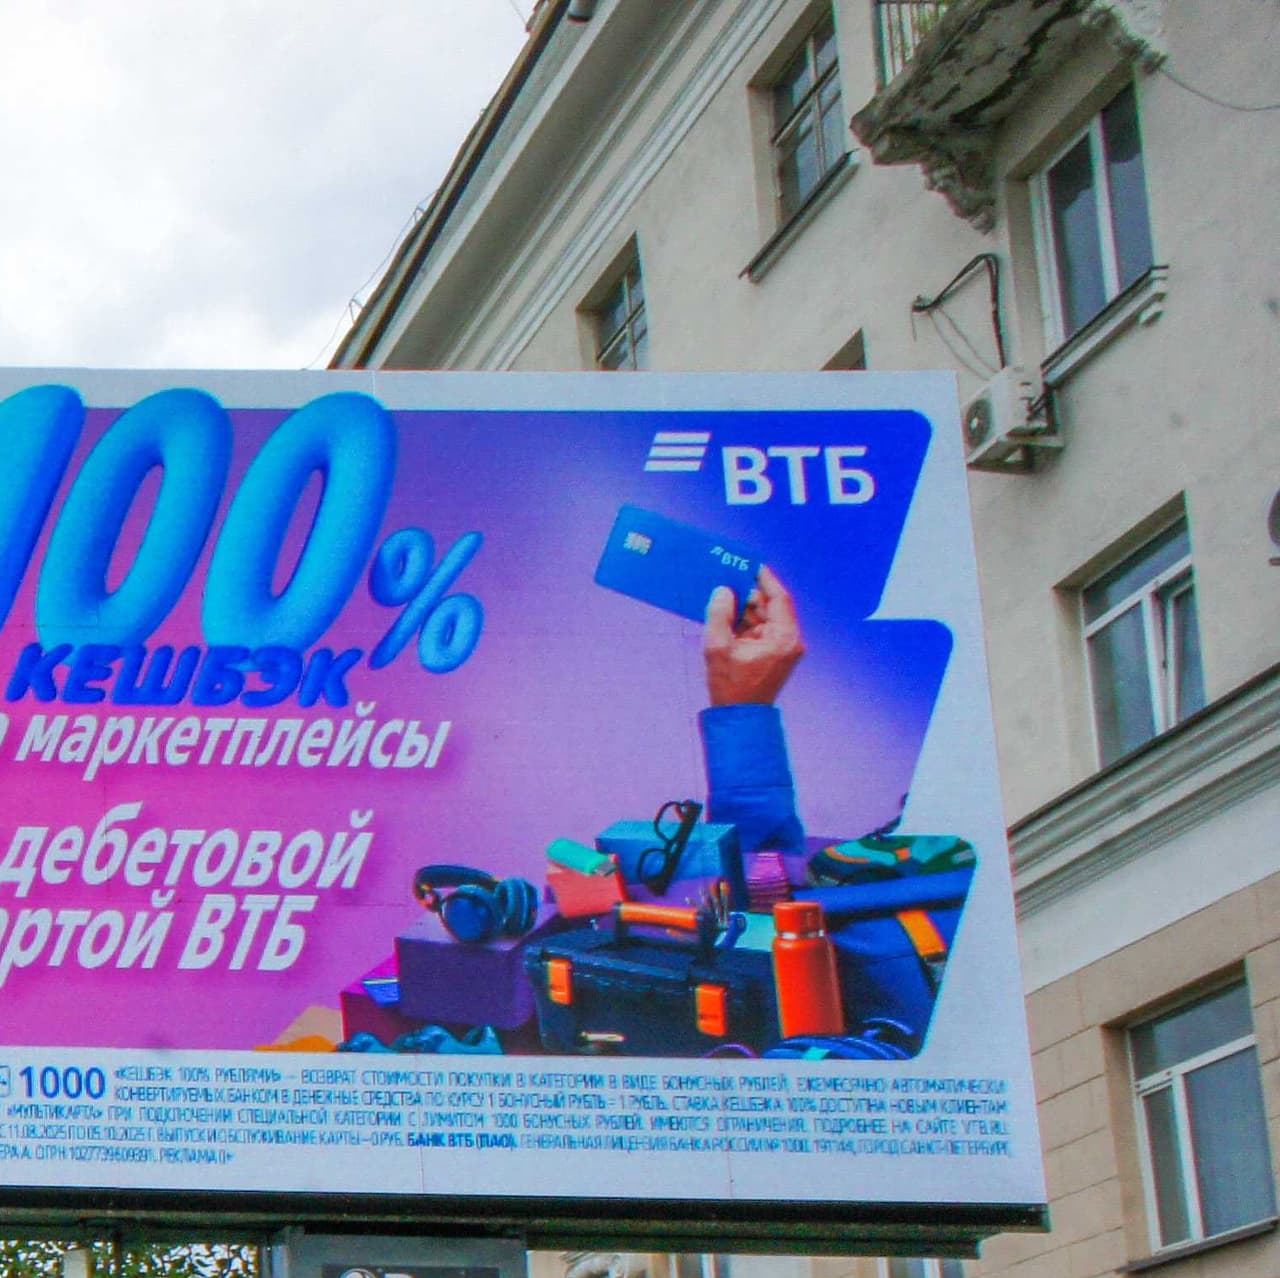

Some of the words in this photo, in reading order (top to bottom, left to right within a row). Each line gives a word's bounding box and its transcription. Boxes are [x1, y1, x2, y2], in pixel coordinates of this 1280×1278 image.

[721, 446, 876, 505] ВТБ
[720, 550, 750, 571] ВТБ
[5, 642, 365, 708] КЕШБЭК
[14, 702, 452, 781] маркетплейсы
[177, 894, 319, 971] ВТБ
[19, 1066, 106, 1099] 1000
